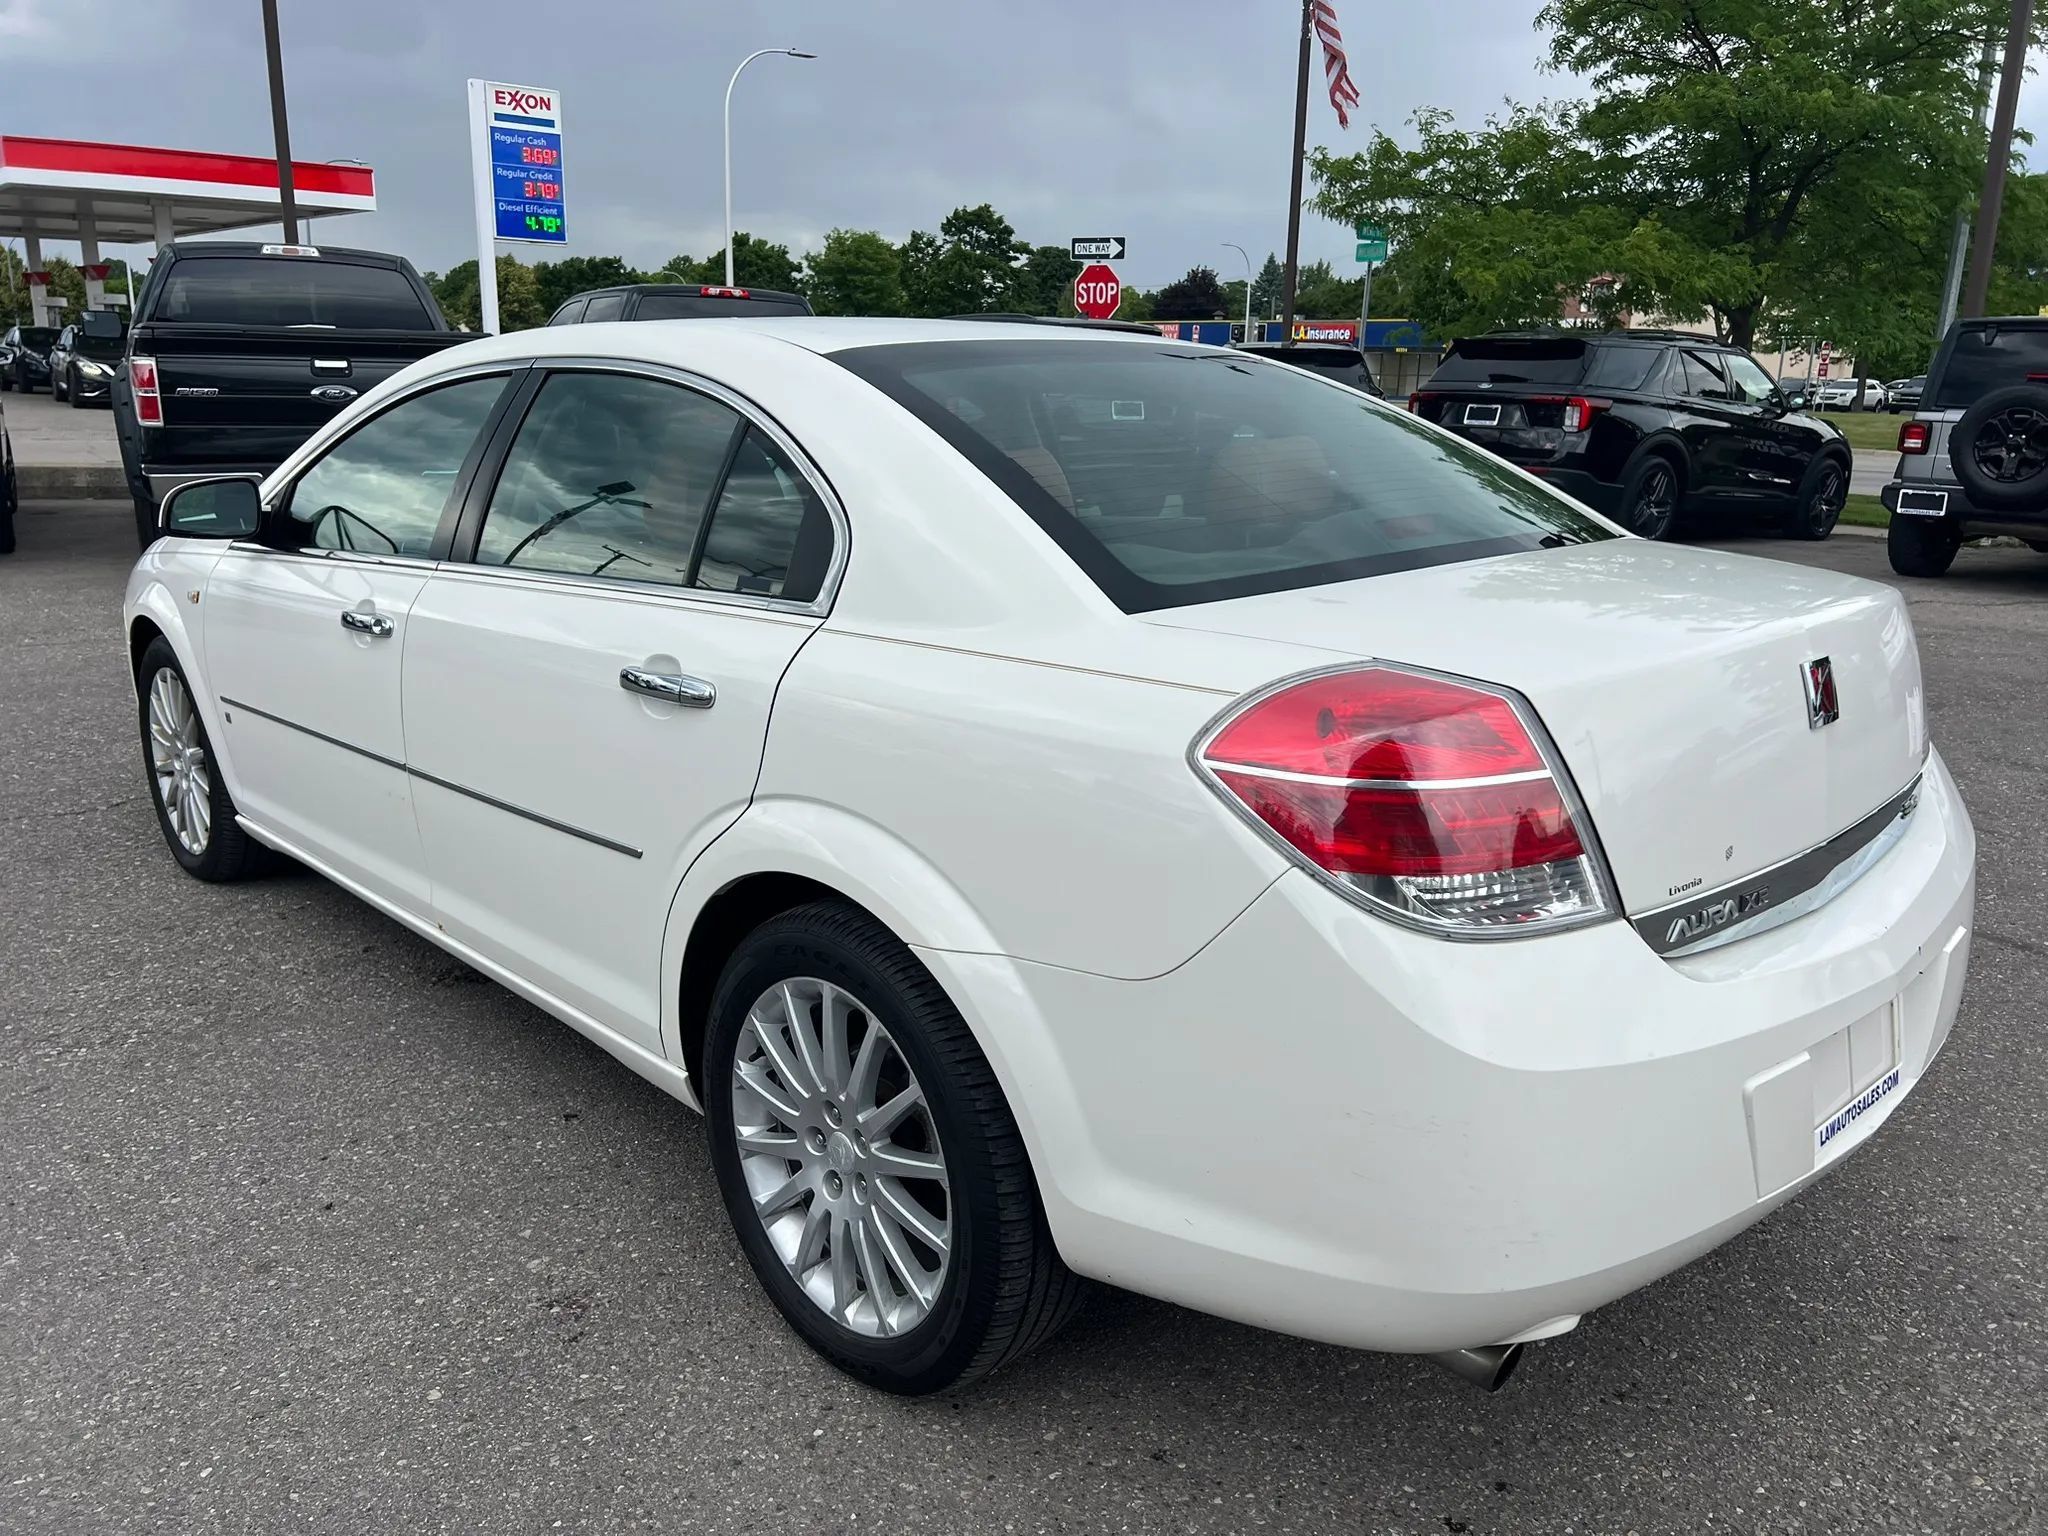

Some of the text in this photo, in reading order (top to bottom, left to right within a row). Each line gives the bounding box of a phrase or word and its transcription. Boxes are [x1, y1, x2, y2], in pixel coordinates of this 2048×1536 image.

[494, 89, 551, 114] EXXON
[494, 132, 547, 146] Regular Cash
[496, 167, 553, 181] Regular Credit
[498, 202, 558, 215] Diesel Efficient
[1076, 244, 1111, 253] ONE WAY
[1078, 282, 1117, 304] STOP
[1668, 877, 1703, 896] Livonia
[1665, 899, 1739, 943] AURA
[1820, 1070, 1899, 1147] LAWAUTOSALES.COM
